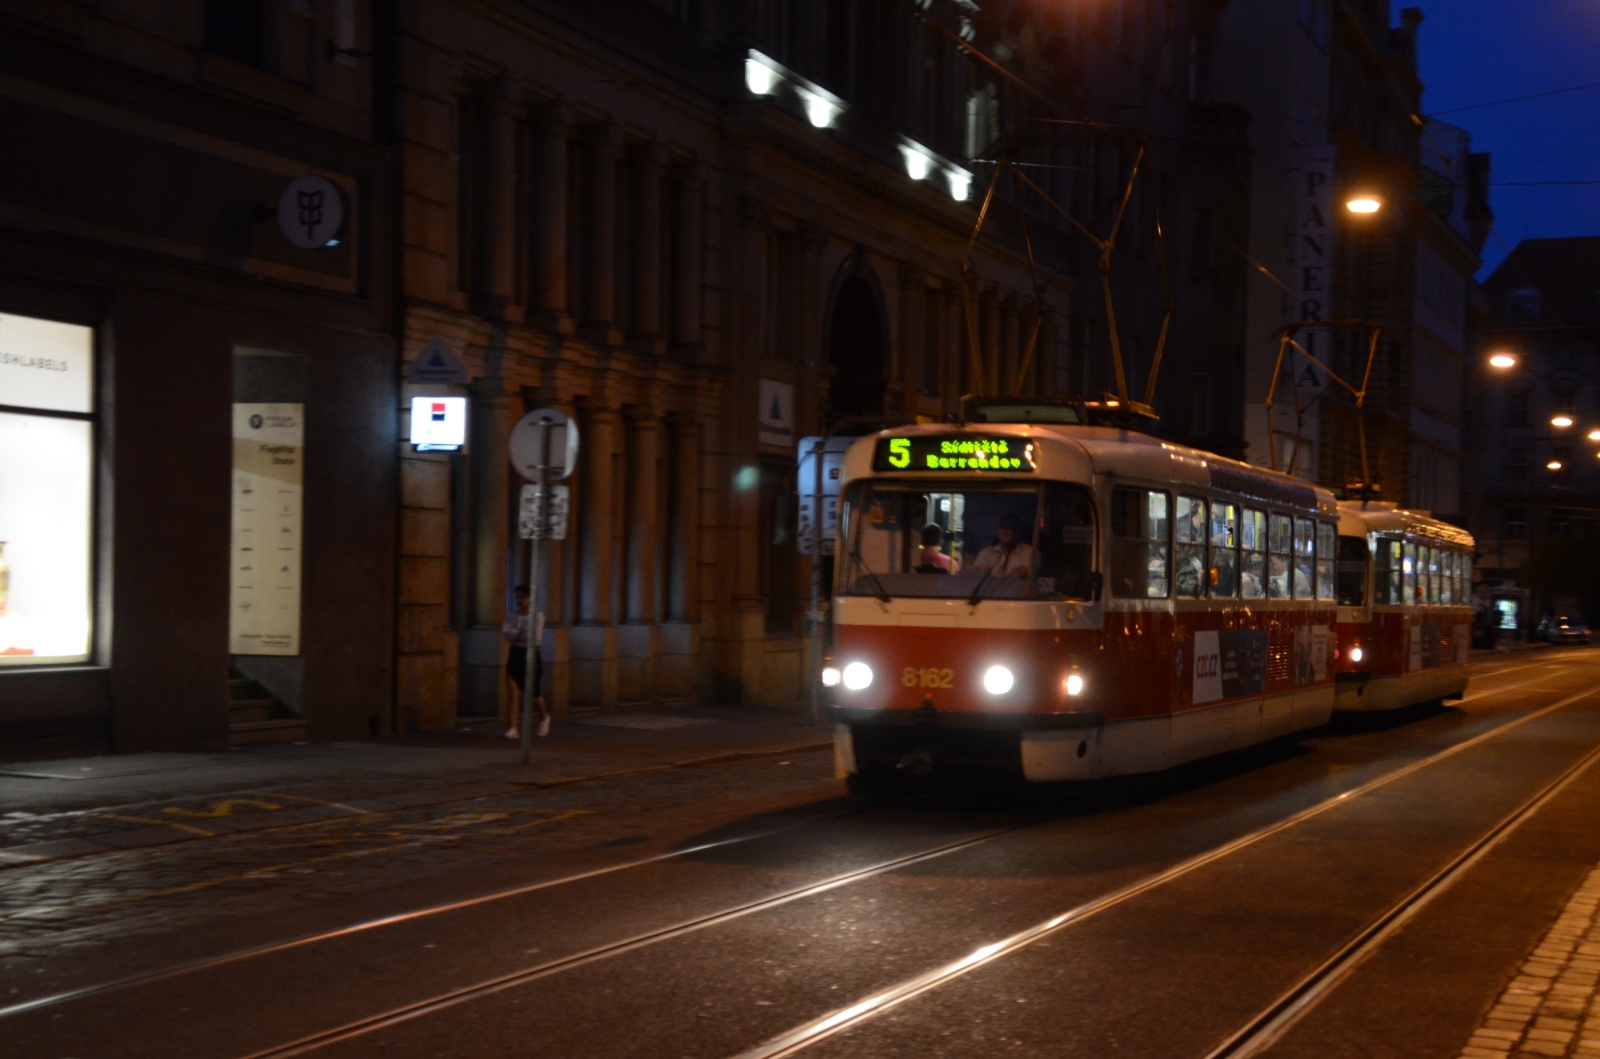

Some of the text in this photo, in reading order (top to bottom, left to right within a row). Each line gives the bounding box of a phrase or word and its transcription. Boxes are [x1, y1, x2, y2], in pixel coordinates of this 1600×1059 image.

[1298, 171, 1326, 388] PANERIA
[888, 438, 911, 469] 5
[926, 454, 1021, 469] Barrandov
[902, 667, 955, 688] 8162
